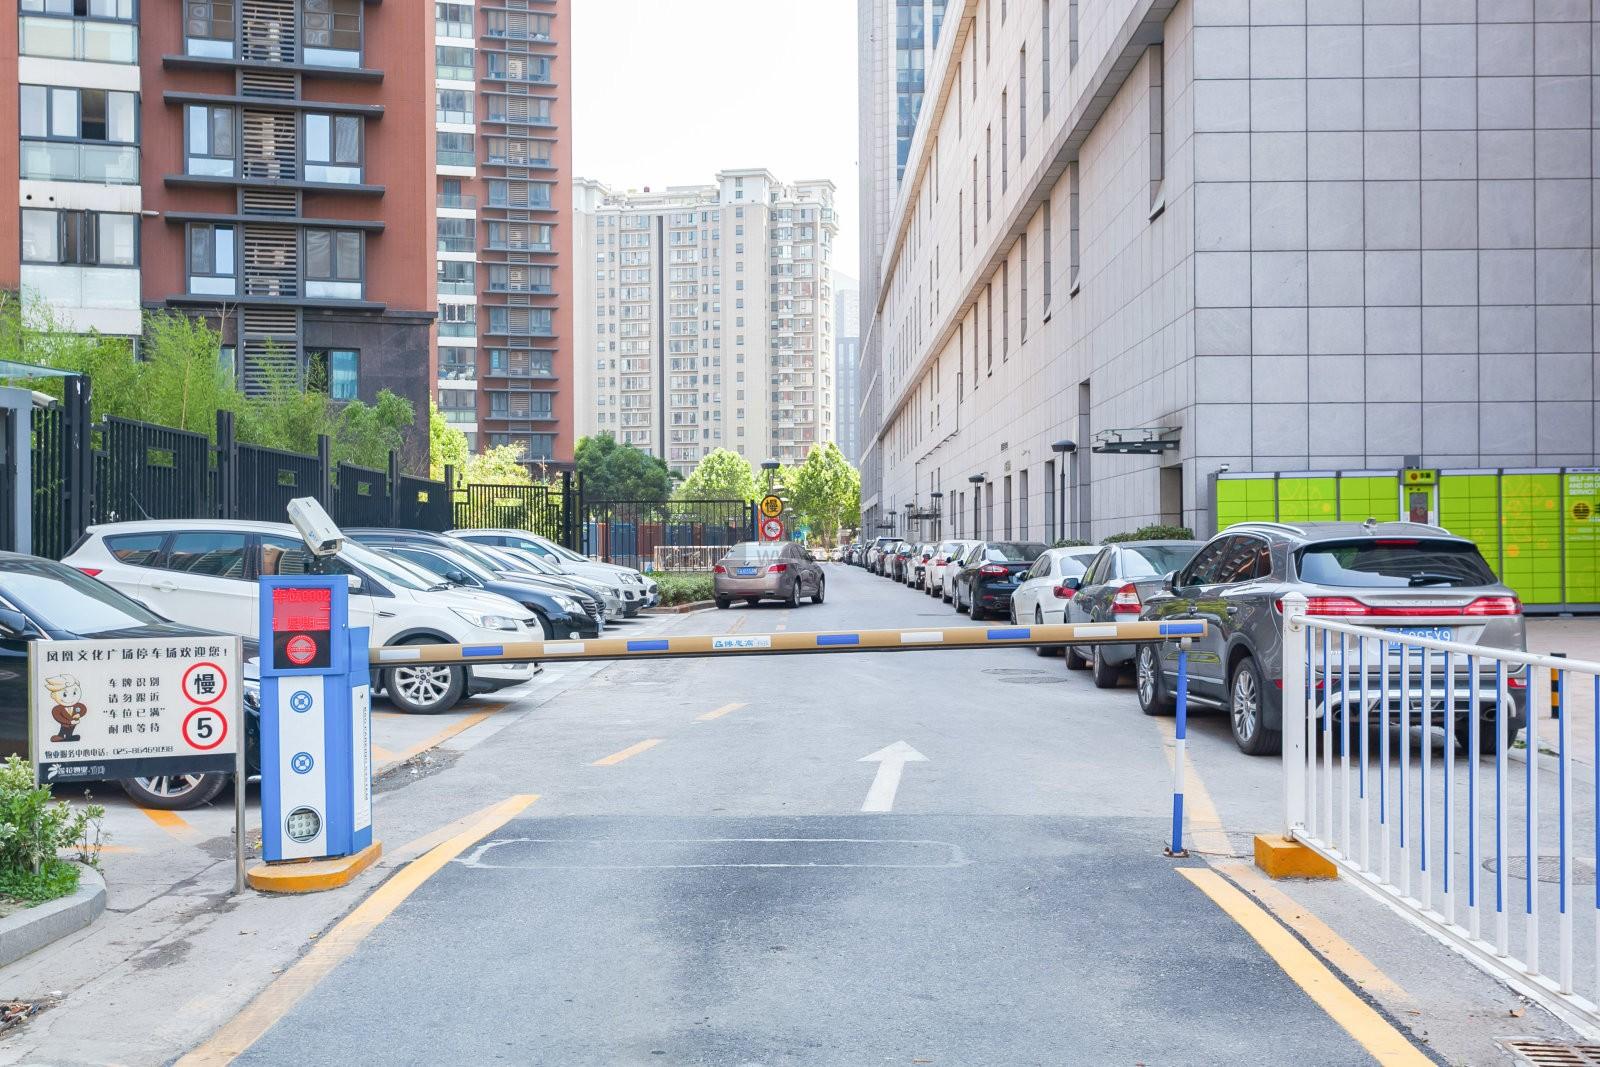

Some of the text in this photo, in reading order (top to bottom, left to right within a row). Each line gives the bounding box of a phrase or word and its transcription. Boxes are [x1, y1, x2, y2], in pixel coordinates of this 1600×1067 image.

[766, 500, 778, 512] 慢
[108, 677, 160, 688] 车牌识别
[194, 673, 216, 695] 慢
[108, 692, 160, 704] 请勿跟近
[108, 724, 160, 735] 耐心等待
[197, 717, 213, 739] 5
